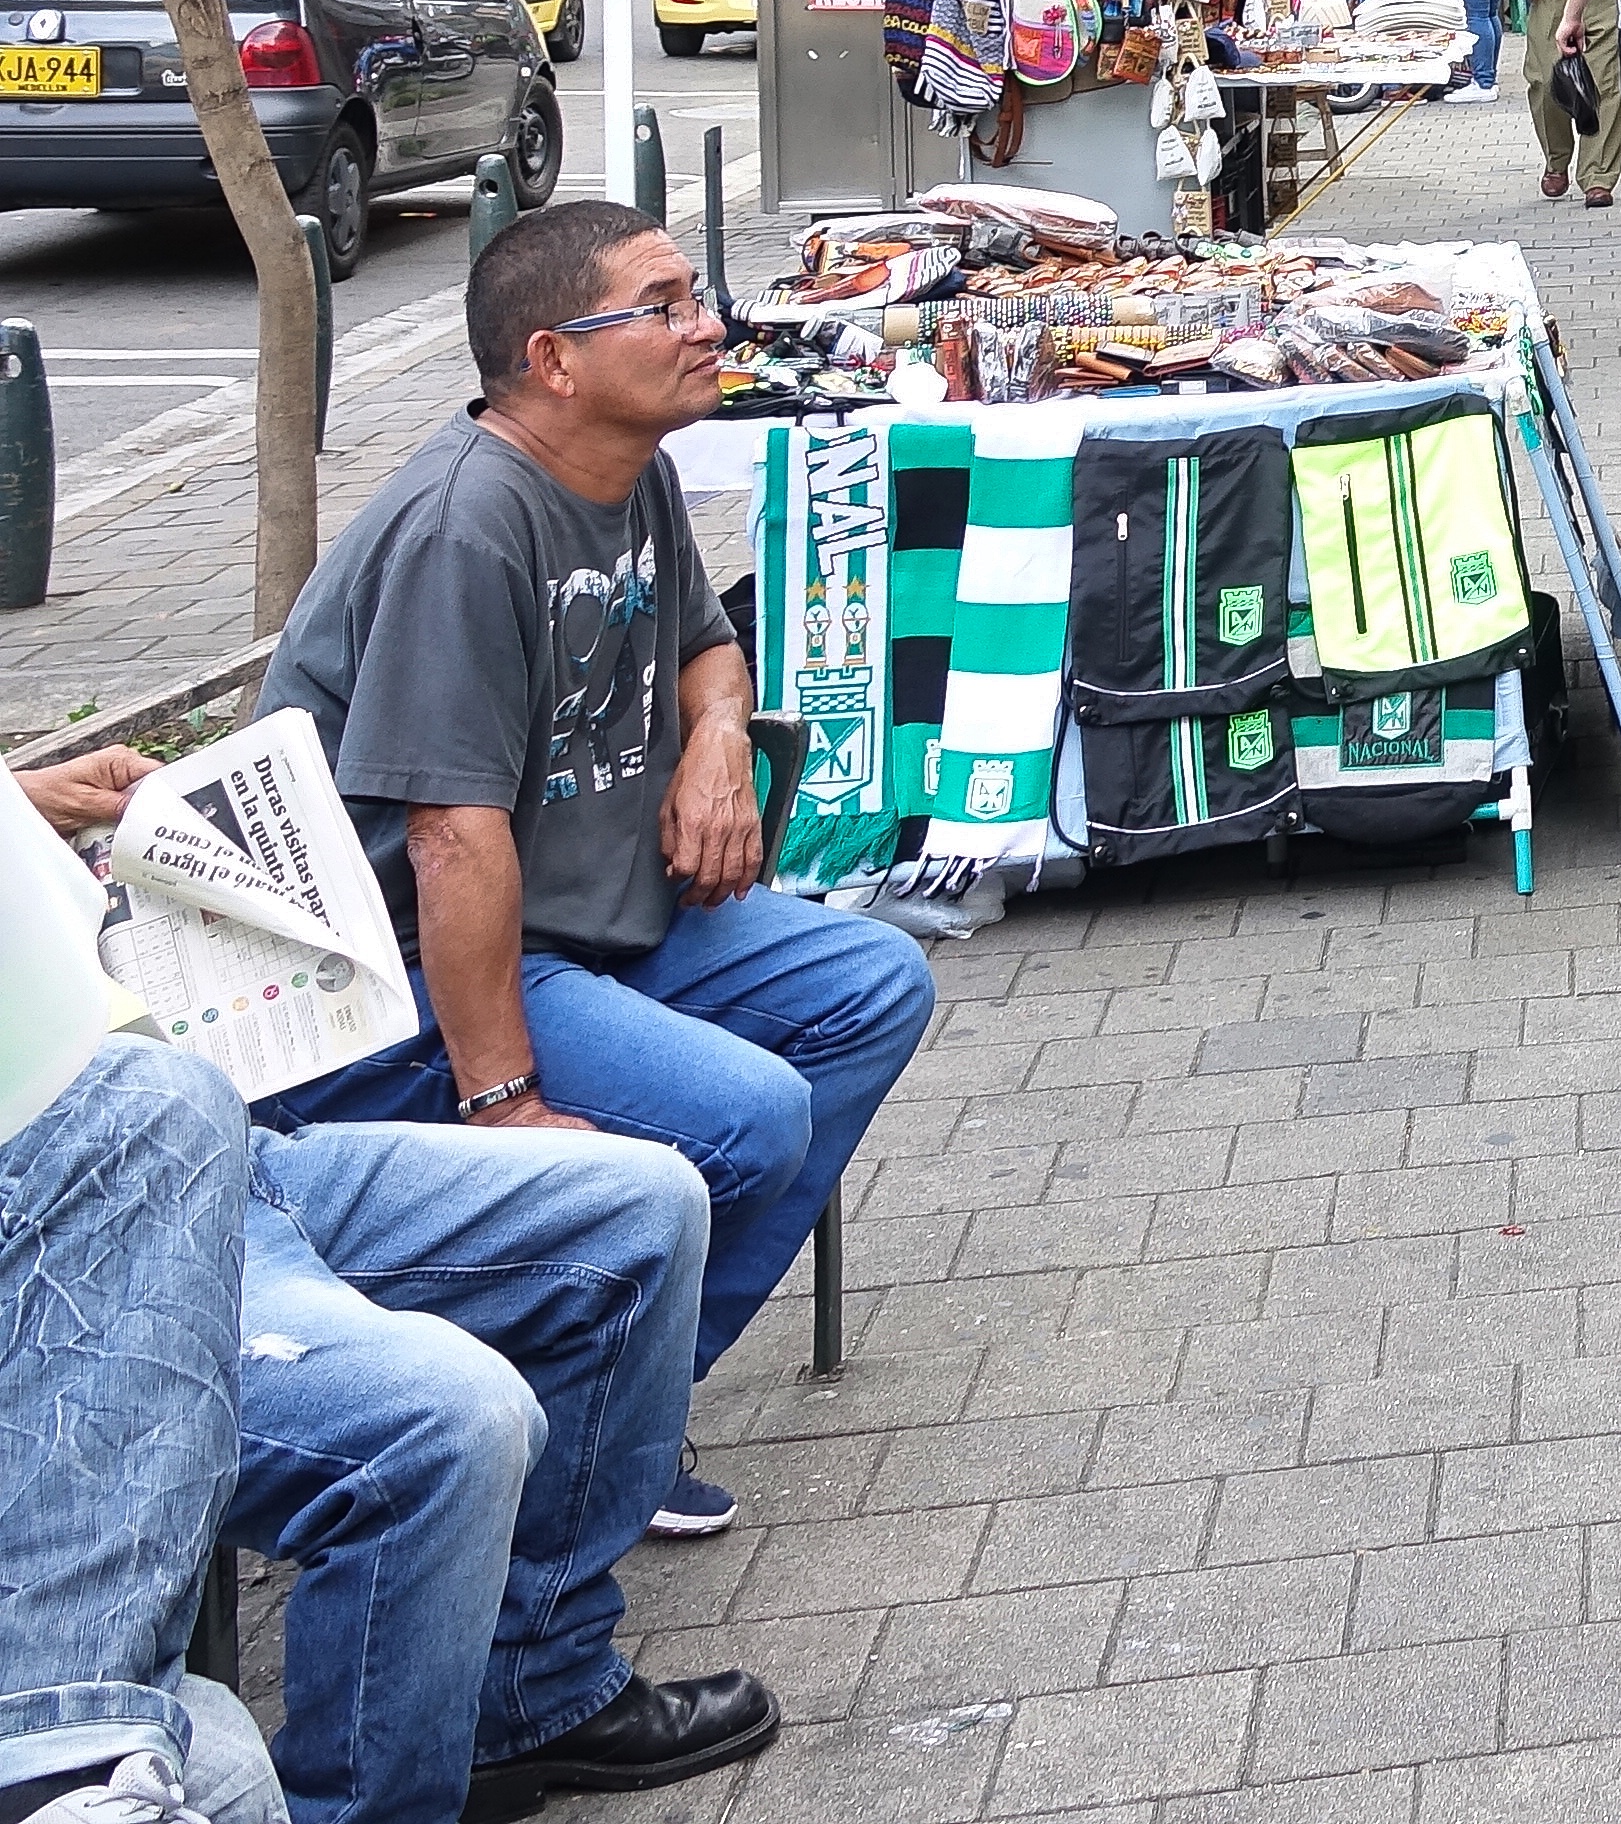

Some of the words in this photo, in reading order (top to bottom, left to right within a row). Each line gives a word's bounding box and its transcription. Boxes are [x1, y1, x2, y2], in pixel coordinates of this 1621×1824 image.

[18, 84, 68, 92] MEDELLIN
[805, 426, 889, 578] NAL
[1347, 739, 1434, 765] NACIONAL
[230, 770, 248, 792] en
[242, 794, 261, 821] la
[254, 754, 287, 816] Duras
[280, 817, 314, 885] visitas
[155, 825, 212, 851] cuero
[142, 844, 153, 861] y
[159, 852, 207, 878] tigre
[248, 819, 287, 885] quinta
[208, 861, 229, 883] el
